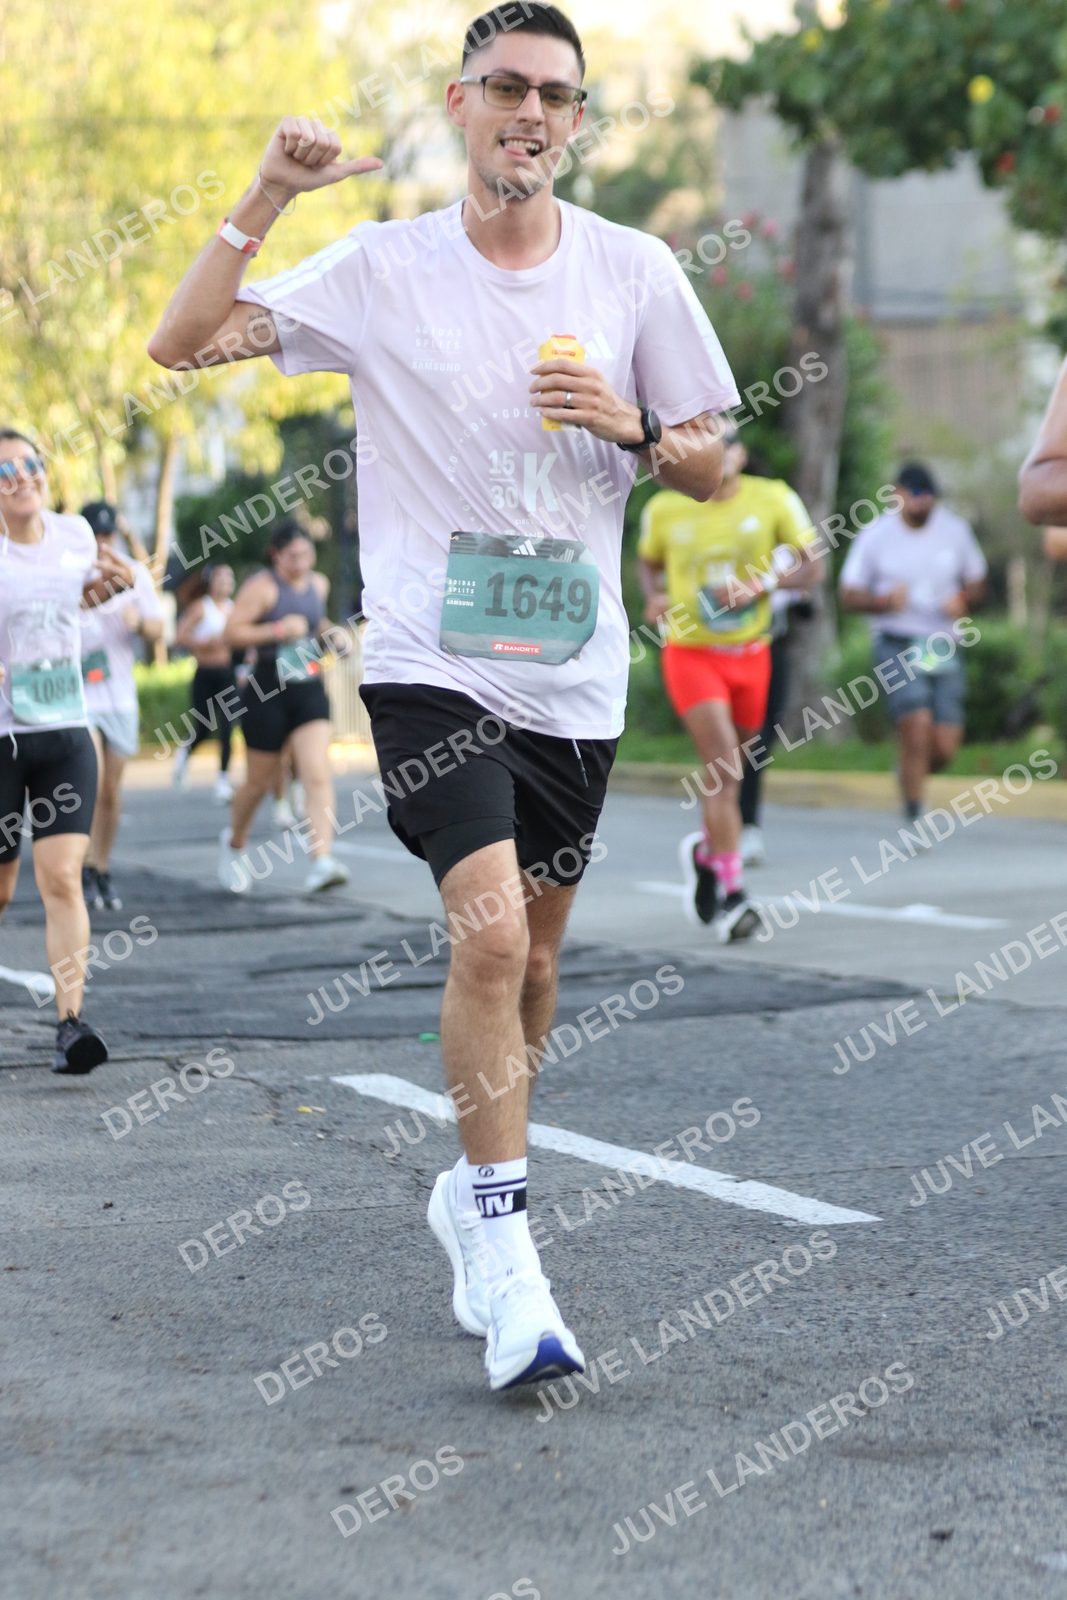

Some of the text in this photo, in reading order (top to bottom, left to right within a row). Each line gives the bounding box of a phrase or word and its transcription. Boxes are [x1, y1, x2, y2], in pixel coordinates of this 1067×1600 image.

[502, 408, 530, 419] GDL
[488, 450, 560, 512] 15 K
[491, 485, 519, 509] 30
[485, 571, 592, 624] 1649
